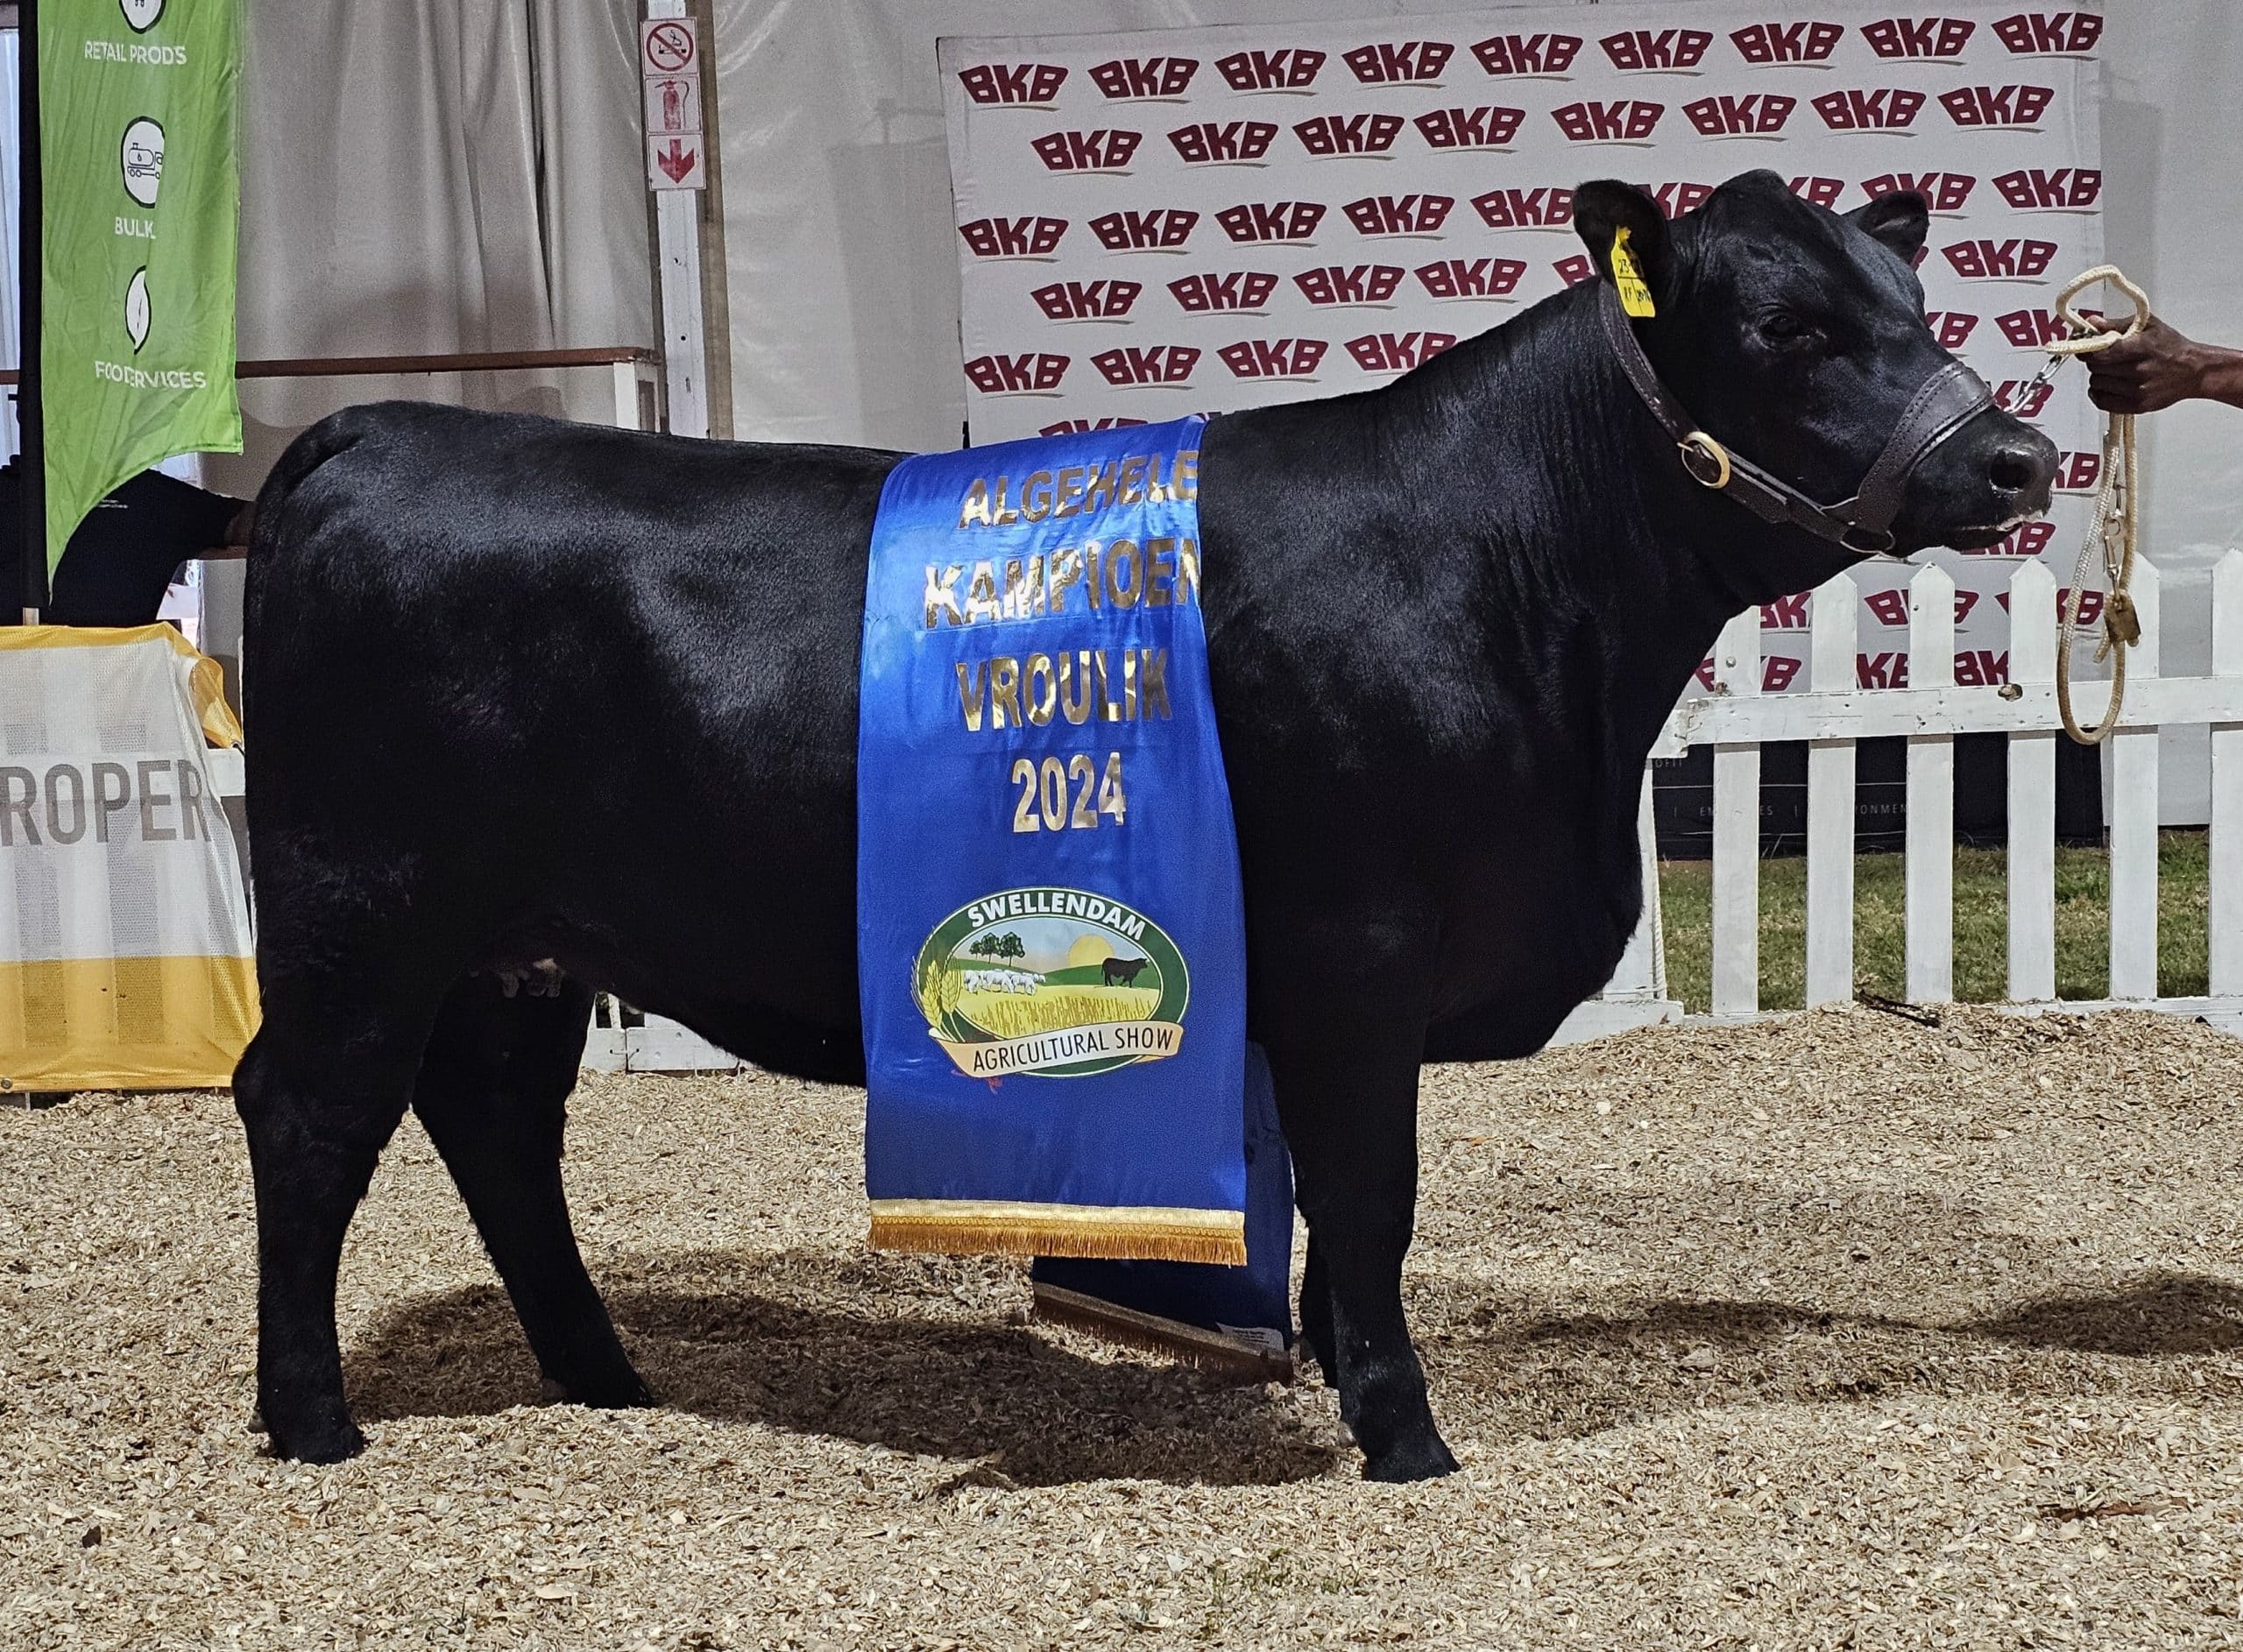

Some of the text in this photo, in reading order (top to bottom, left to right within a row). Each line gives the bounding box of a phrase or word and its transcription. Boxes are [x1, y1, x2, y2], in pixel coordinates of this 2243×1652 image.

[84, 40, 127, 62] RETAIL
[959, 12, 2103, 103] BKB BKB BKB BKB BKB BKB BKB BKB BKB
[1030, 85, 2054, 171] BKB BKB BKB BKB BKB BKB BKB BKB
[115, 216, 157, 240] BULK
[959, 215, 1069, 257] BKB
[1087, 208, 1199, 250] BKB
[1215, 201, 1327, 243] BKB
[1342, 194, 1454, 235] BKB
[1469, 187, 1574, 229] BKB
[1991, 168, 2101, 209] BKB
[1030, 279, 1143, 321] BKB
[1166, 272, 1278, 313] BKB
[1292, 265, 1405, 306] BKB
[1413, 258, 1527, 299] BKB
[1941, 239, 2058, 279] BKB
[964, 353, 1071, 394] BKB
[1090, 345, 1201, 386] BKB
[1216, 338, 1329, 380] BKB
[959, 450, 1199, 529] ALGEHELE
[924, 537, 1201, 629] KAMPIOEN
[955, 647, 1173, 732] VROULIK
[1012, 751, 1128, 833] 2024
[967, 891, 1146, 941] SWELLENDAM
[973, 1026, 1174, 1073] AGRICULTURAL SHOW
